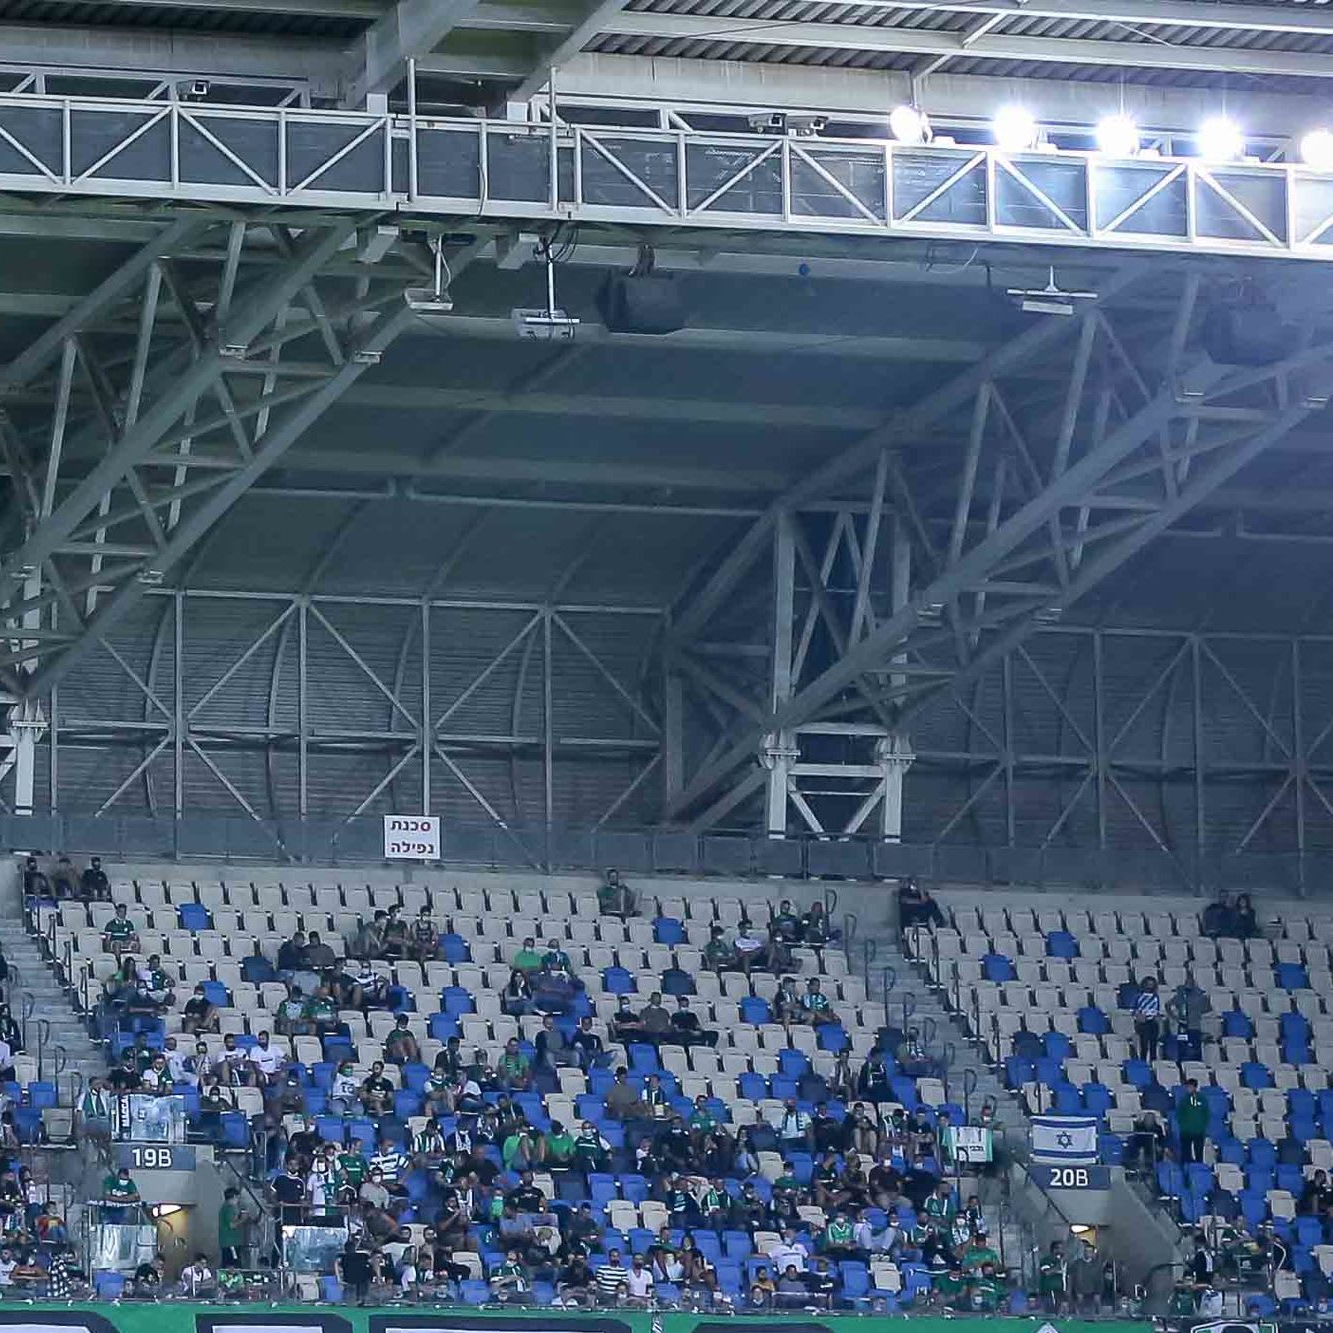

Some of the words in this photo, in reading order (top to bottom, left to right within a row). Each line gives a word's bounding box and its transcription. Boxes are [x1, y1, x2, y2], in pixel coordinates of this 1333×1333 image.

[390, 820, 431, 832] סכנת
[391, 841, 434, 854] נפילה
[132, 1148, 172, 1167] 19B
[1050, 1168, 1088, 1187] 20B
